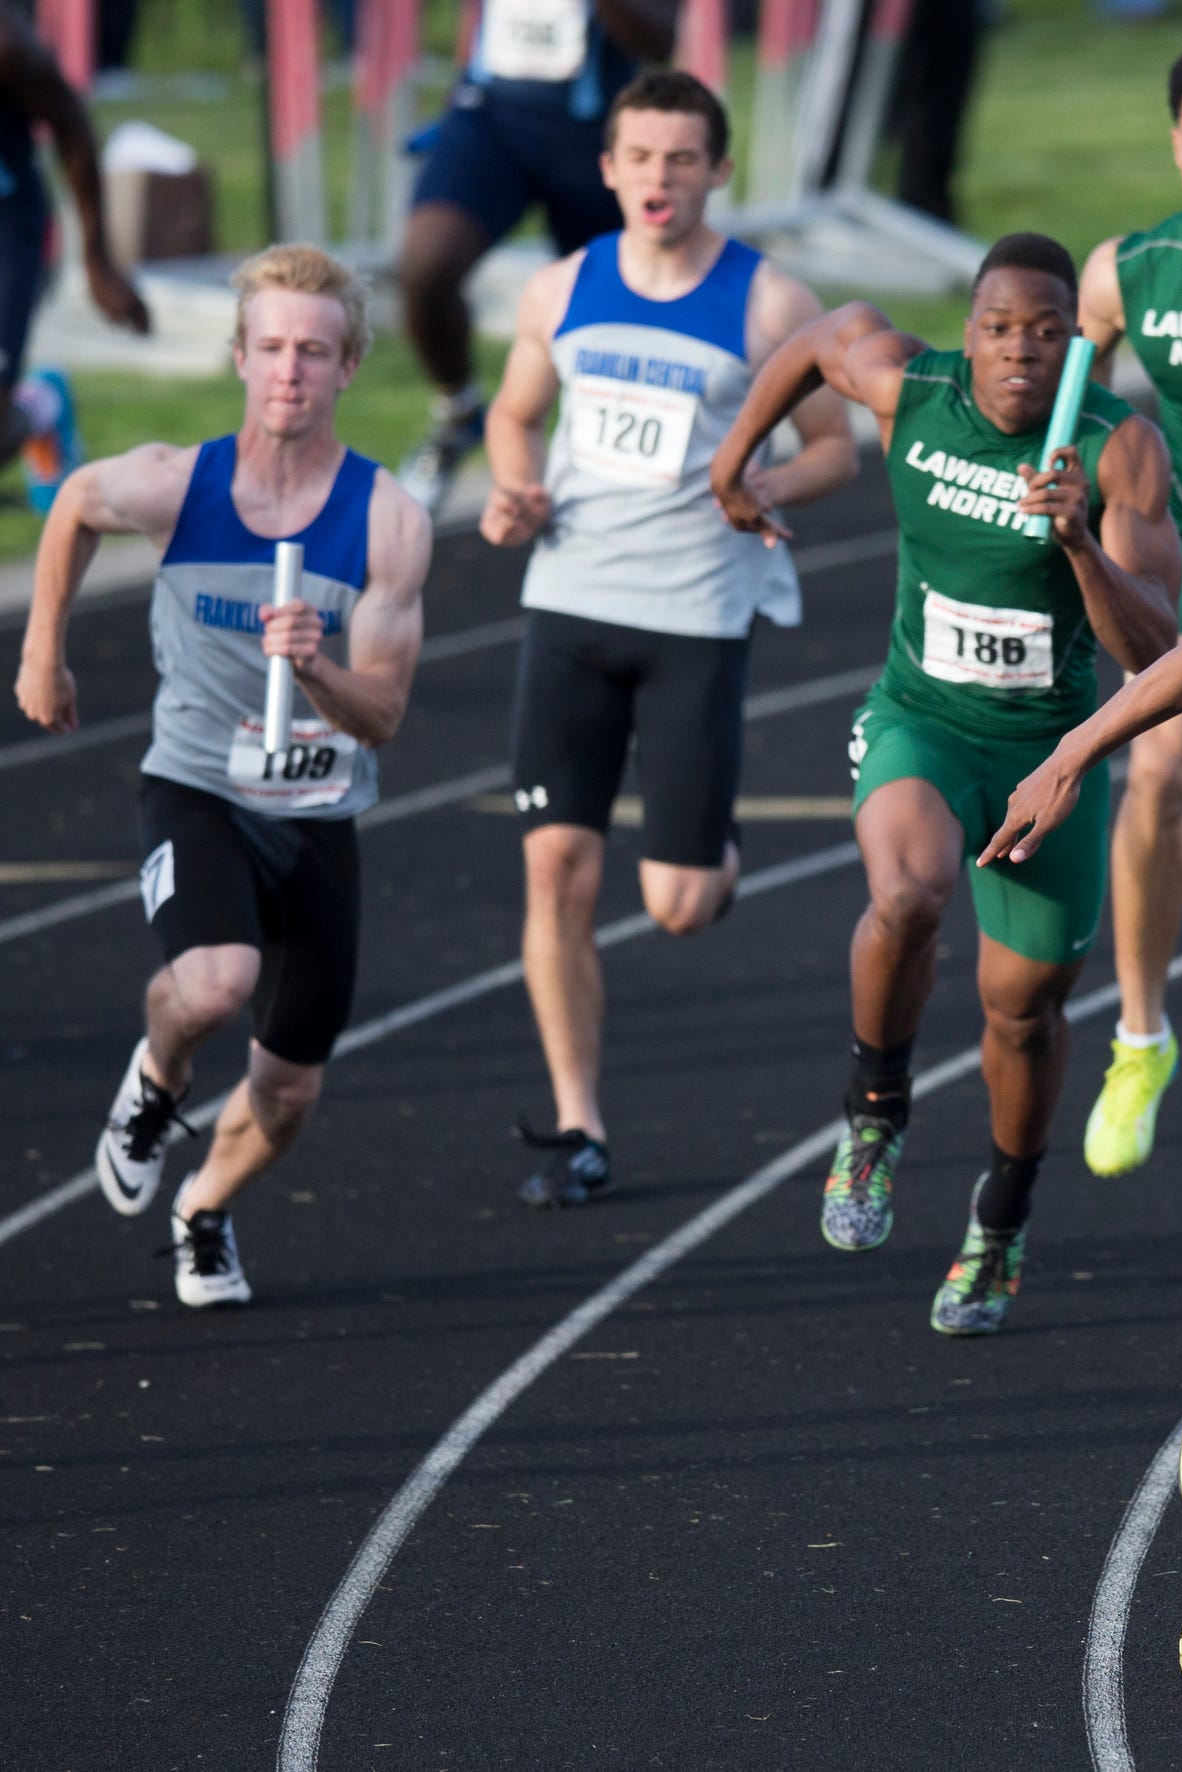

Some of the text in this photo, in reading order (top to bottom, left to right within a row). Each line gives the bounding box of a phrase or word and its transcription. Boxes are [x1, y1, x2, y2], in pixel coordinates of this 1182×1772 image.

[598, 406, 663, 458] 120
[951, 626, 1026, 666] 186
[262, 745, 338, 781] 109
